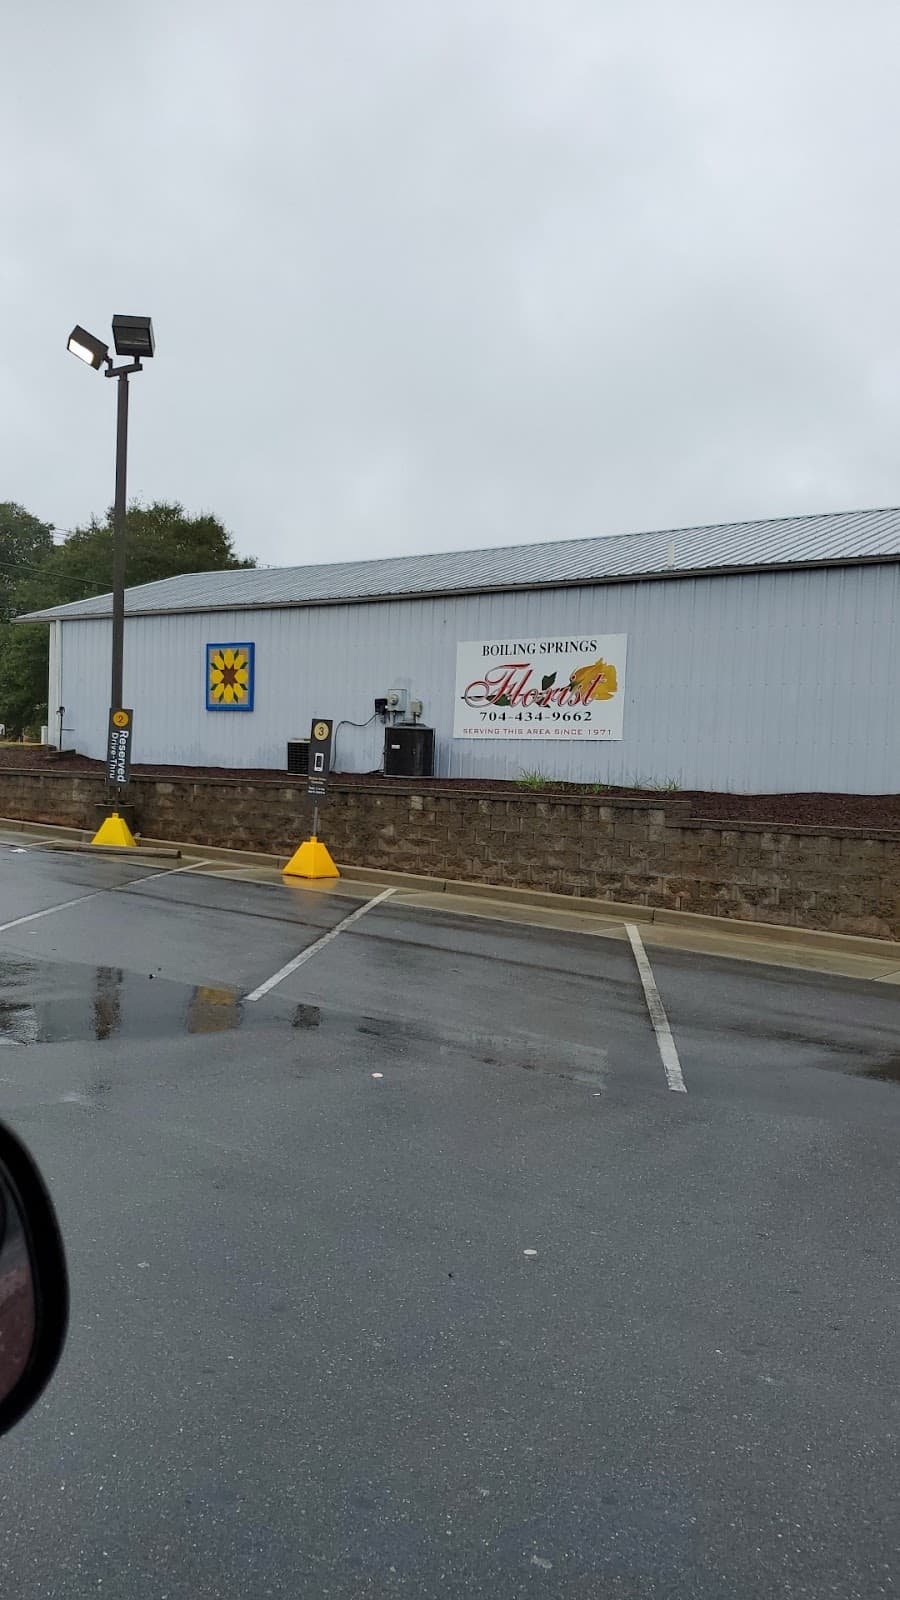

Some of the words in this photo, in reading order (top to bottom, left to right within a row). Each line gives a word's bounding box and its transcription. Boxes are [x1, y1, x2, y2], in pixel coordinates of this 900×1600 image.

[482, 643, 536, 656] BOILING
[539, 640, 598, 654] SPRINGS
[464, 663, 606, 708] Florist
[118, 715, 124, 724] 2
[480, 711, 593, 722] 704-434-9662
[318, 726, 324, 736] 3
[110, 732, 119, 778] Drive-Thru
[117, 730, 129, 782] Reserved
